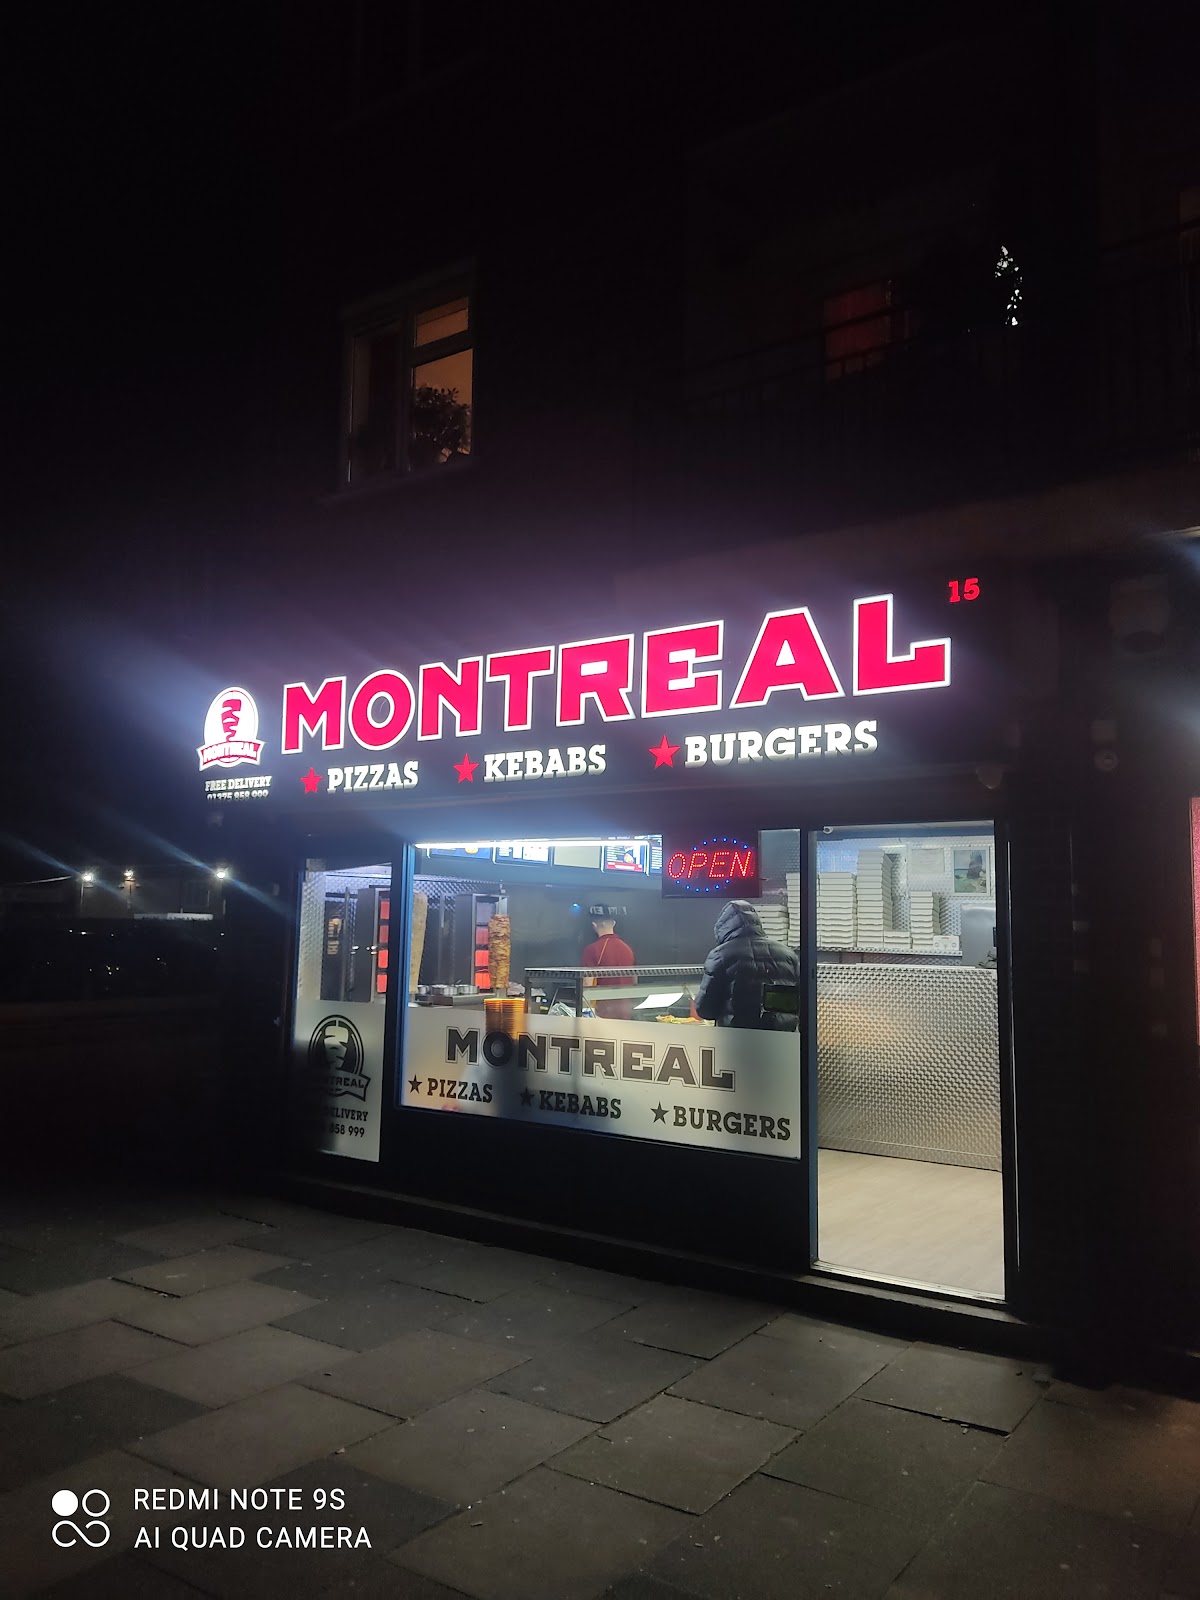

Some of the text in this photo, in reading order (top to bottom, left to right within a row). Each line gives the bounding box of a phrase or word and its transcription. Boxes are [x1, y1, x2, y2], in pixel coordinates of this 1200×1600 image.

[948, 578, 980, 603] 15
[281, 593, 952, 755] MONTREAL
[326, 719, 878, 794] PIZZAS KEBABS BURGERS
[205, 775, 272, 792] FREE DELIVERY
[668, 851, 752, 880] OPEN
[445, 1025, 736, 1093] MONTREAL
[324, 1106, 369, 1122] ELIVERY
[427, 1077, 791, 1141] PIZZAS KEBABS BURGERS
[348, 1125, 365, 1138] 999
